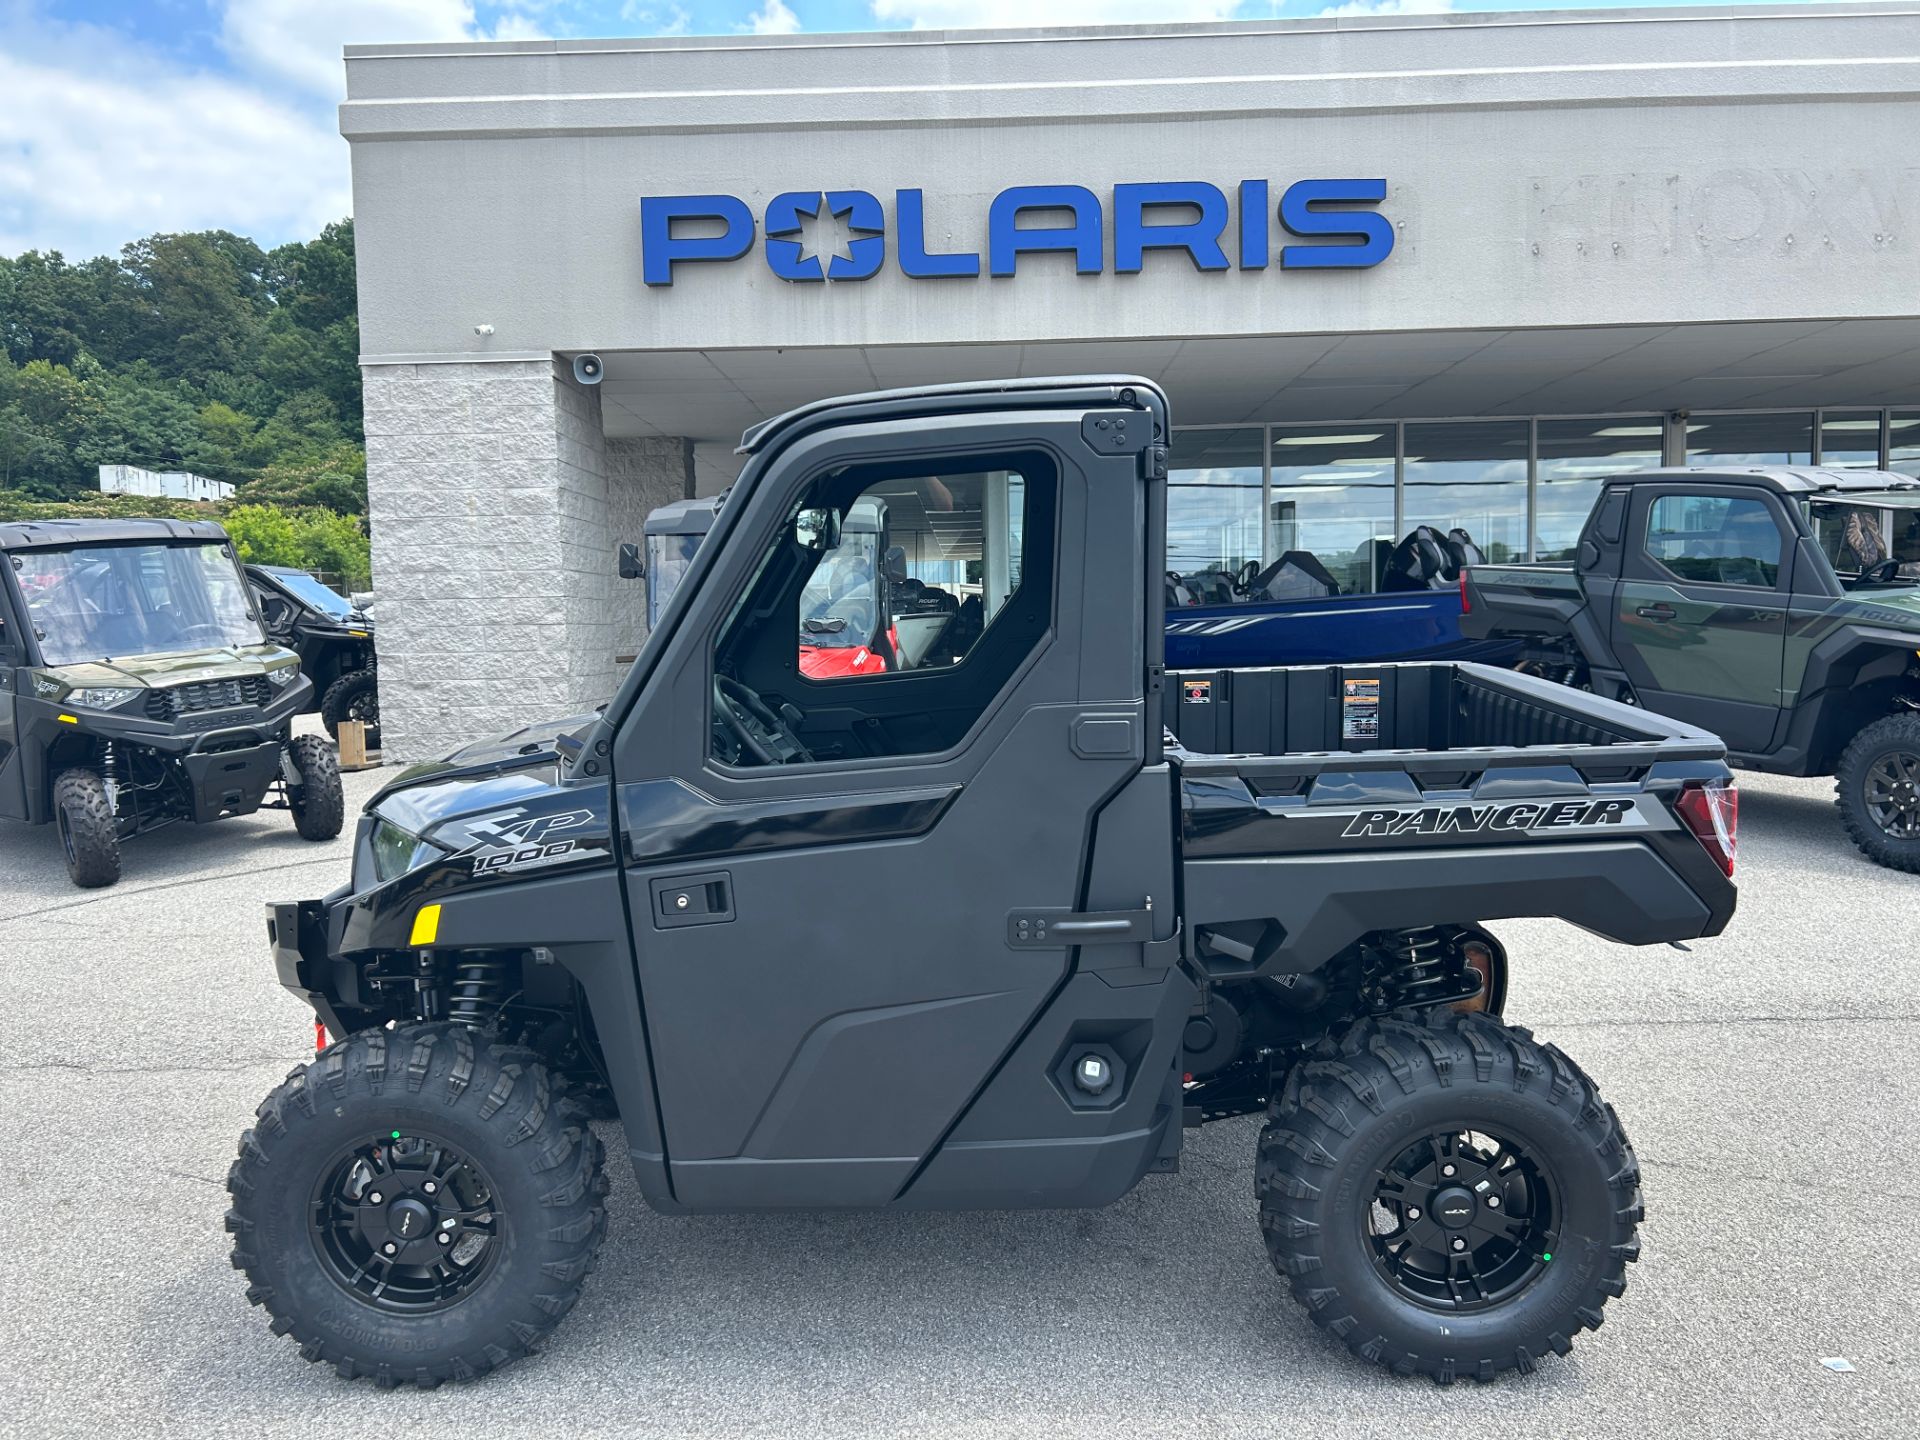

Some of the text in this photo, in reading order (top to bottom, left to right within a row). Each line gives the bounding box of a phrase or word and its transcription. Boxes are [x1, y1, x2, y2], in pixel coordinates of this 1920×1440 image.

[640, 178, 1396, 287] POLARIS
[1858, 609, 1913, 624] 1000
[185, 711, 255, 731] POLARIS
[444, 808, 595, 861] XP
[1340, 798, 1636, 838] RANGER
[472, 839, 576, 874] 1000
